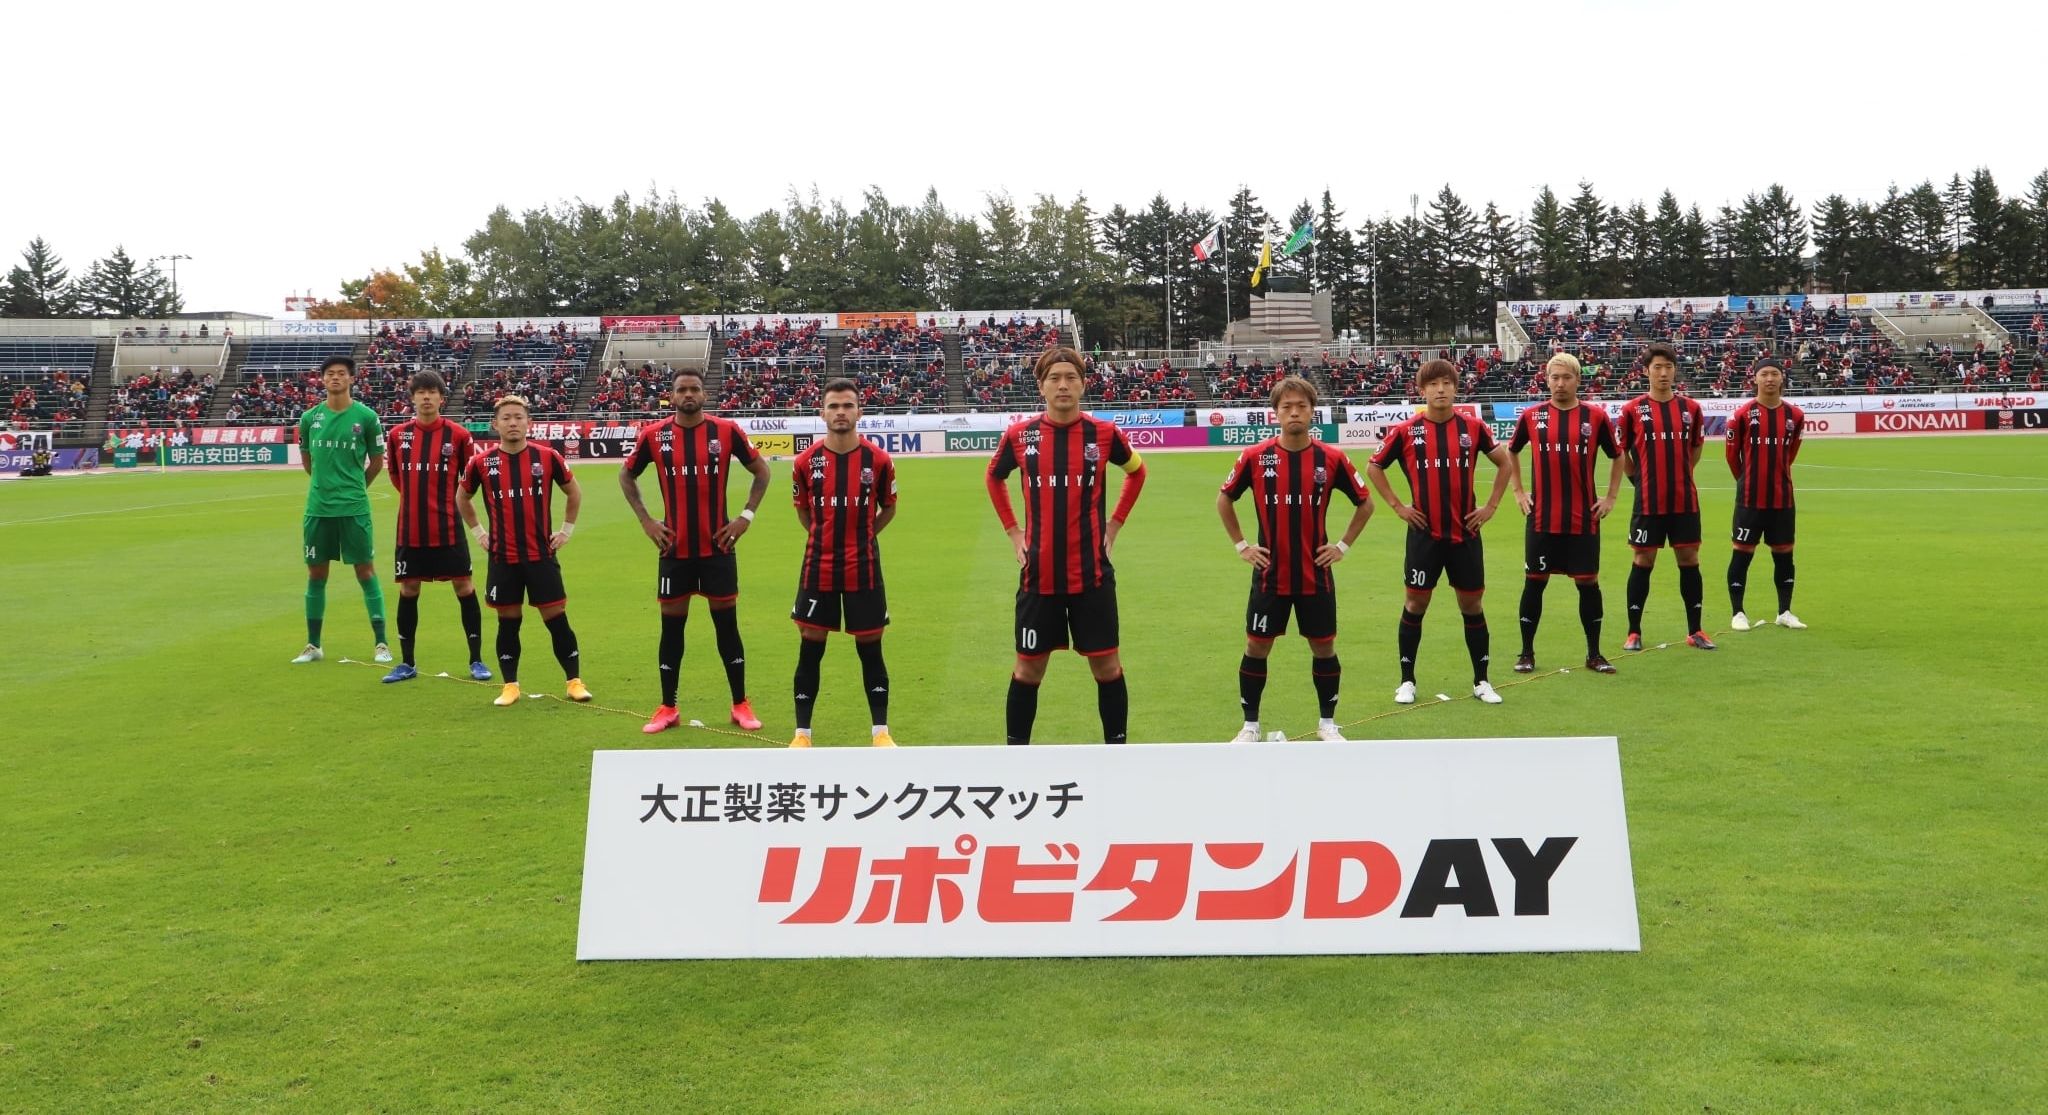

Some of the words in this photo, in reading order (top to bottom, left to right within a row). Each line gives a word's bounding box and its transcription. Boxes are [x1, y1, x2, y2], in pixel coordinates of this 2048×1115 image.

[750, 419, 788, 431] CLASSIC
[1113, 413, 1164, 425] 白い恋人
[1874, 412, 1967, 431] KONAMI
[526, 423, 582, 440] 坂良太
[1346, 429, 1371, 438] 2020
[311, 439, 356, 450] ISHIYA
[950, 437, 998, 450] ROUTE
[1538, 443, 1589, 454] ISHIYA
[171, 447, 273, 464] 明治安田生命
[401, 462, 449, 472] ISHIYA
[664, 464, 719, 476] ISHIYA
[1416, 457, 1469, 469] ISHIYA
[1028, 475, 1095, 488] ISHIYA
[492, 486, 543, 499] ISHIYA
[812, 496, 869, 507] ISHIYA
[1265, 494, 1322, 506] ISHIYA
[1635, 528, 1648, 544] 20
[1736, 528, 1750, 541] 27
[395, 561, 407, 576] 32
[1539, 556, 1547, 571] 5
[1410, 568, 1426, 586] 30
[489, 585, 497, 601] 4
[661, 577, 671, 595] 11
[807, 599, 818, 618] 7
[1252, 612, 1268, 633] 14
[1022, 627, 1037, 650] 10
[639, 782, 1084, 823] 大正製薬サンクスマッチ
[757, 833, 1580, 925] リポビタンDAY
